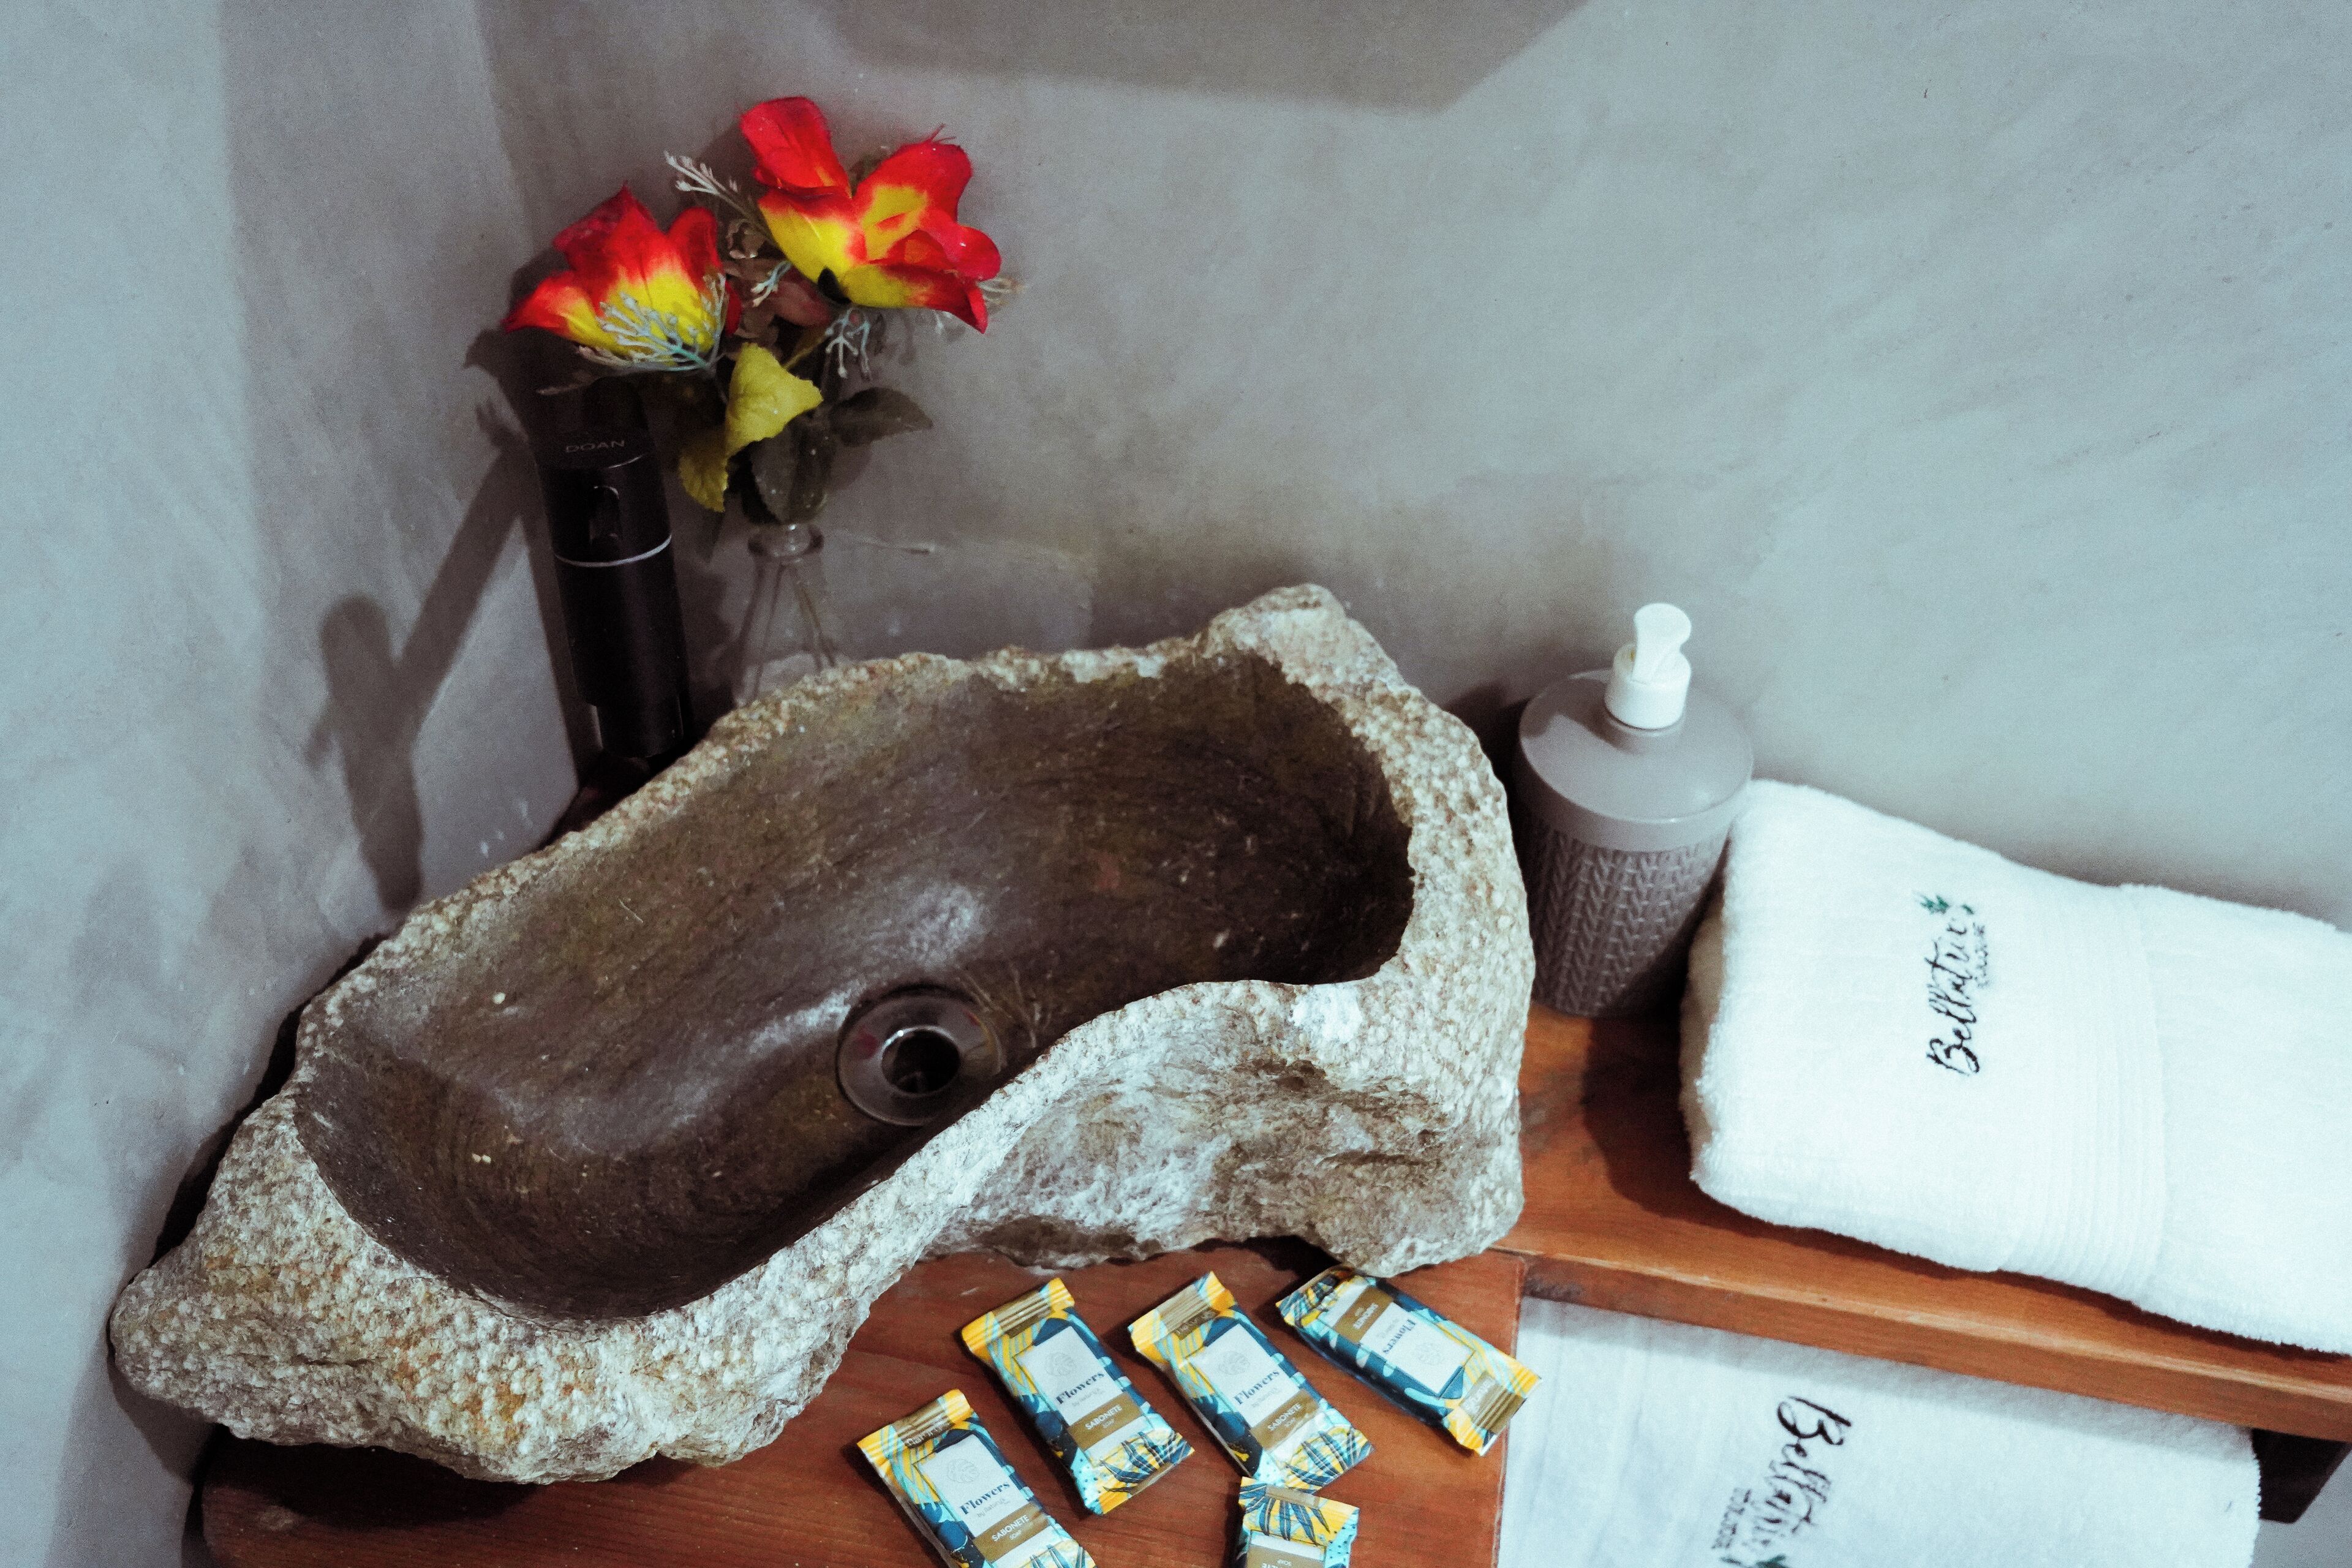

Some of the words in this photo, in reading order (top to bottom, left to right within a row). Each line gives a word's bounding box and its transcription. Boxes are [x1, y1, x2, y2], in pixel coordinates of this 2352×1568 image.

[1383, 1319, 1416, 1354] Flowers
[1055, 1372, 1104, 1404] Flowers
[1234, 1370, 1280, 1405] Flowers
[1085, 1404, 1123, 1430] SABONETE
[1267, 1403, 1302, 1431] SABONETE
[960, 1482, 1011, 1515] Flowers
[992, 1514, 1030, 1542] SABONETE
